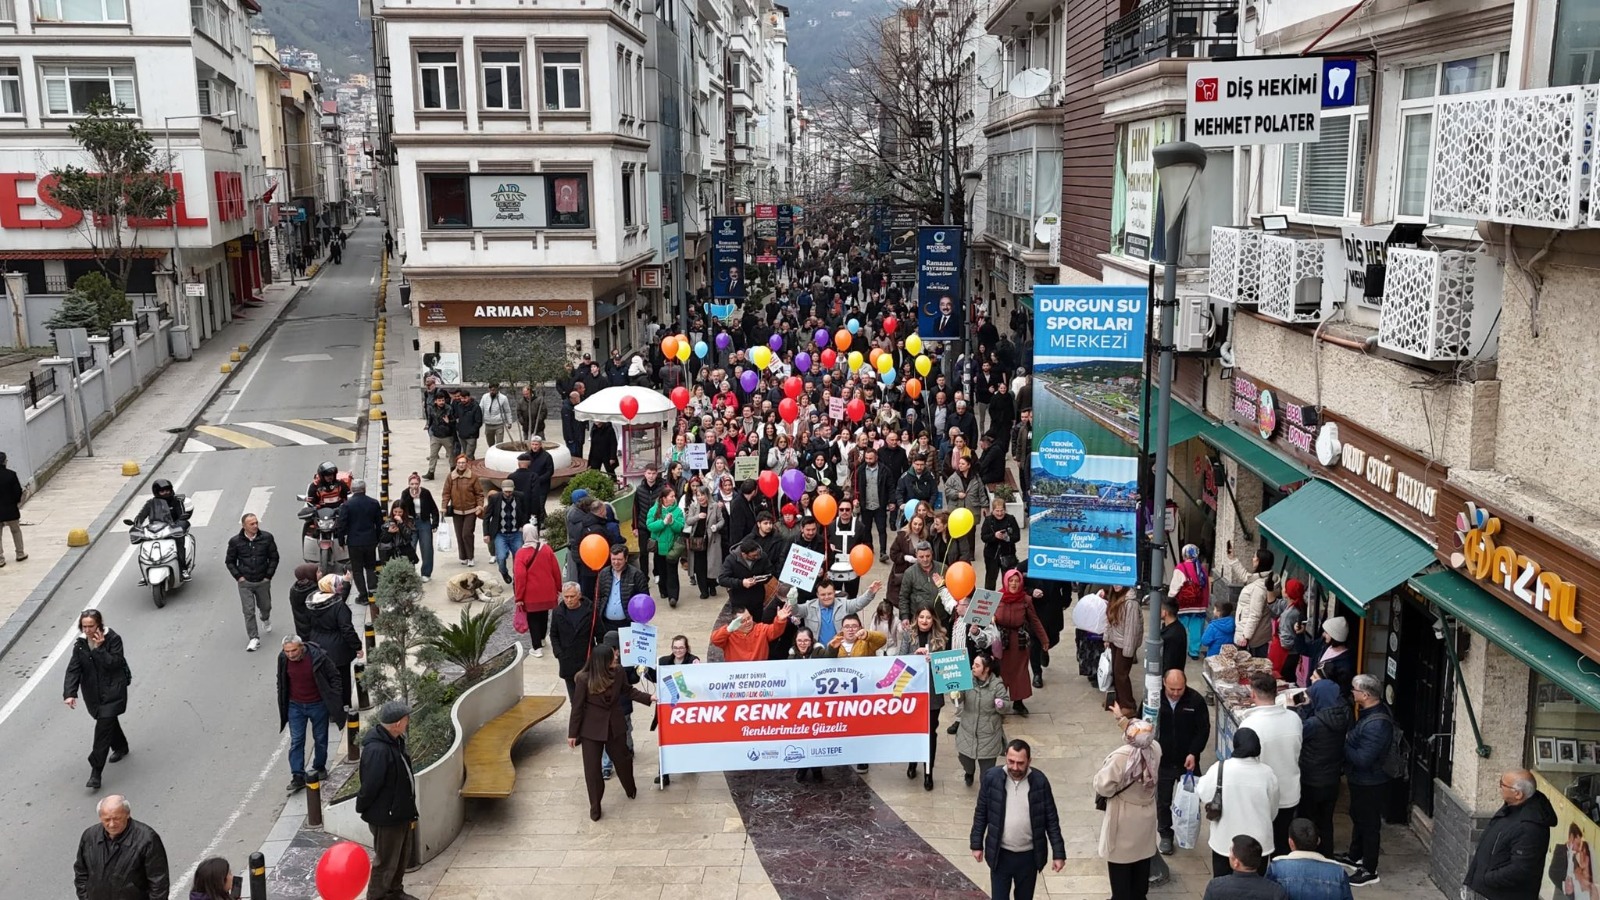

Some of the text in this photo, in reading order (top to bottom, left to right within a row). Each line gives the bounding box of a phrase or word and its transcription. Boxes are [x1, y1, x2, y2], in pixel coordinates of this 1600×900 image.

[1227, 73, 1317, 100] DİŞ HEKİMİ
[1194, 113, 1315, 136] MEHMET POLATER
[1131, 127, 1150, 164] HKM
[1345, 233, 1364, 266] DİŞ
[645, 272, 656, 284] E
[474, 305, 534, 317] ARMAN
[1040, 299, 1140, 313] DURGUN SU
[1046, 317, 1133, 331] SPORLARI
[1051, 333, 1127, 349] MERKEZİ
[1288, 425, 1312, 453] DONUT
[1342, 443, 1438, 517] ORDU CEVİZ HELVASI
[790, 560, 815, 572] HERKESE
[792, 553, 817, 567] SEVGİMİZ
[792, 567, 809, 577] YETER
[810, 667, 837, 681] ALTINORDU
[709, 680, 786, 691] DOWN SENDROMU
[815, 677, 858, 695] 52+1
[670, 697, 917, 725] RENK RENK ALTINORDU
[741, 721, 848, 737] Renklerimizle Güzeliz
[827, 746, 842, 754] TEPE
